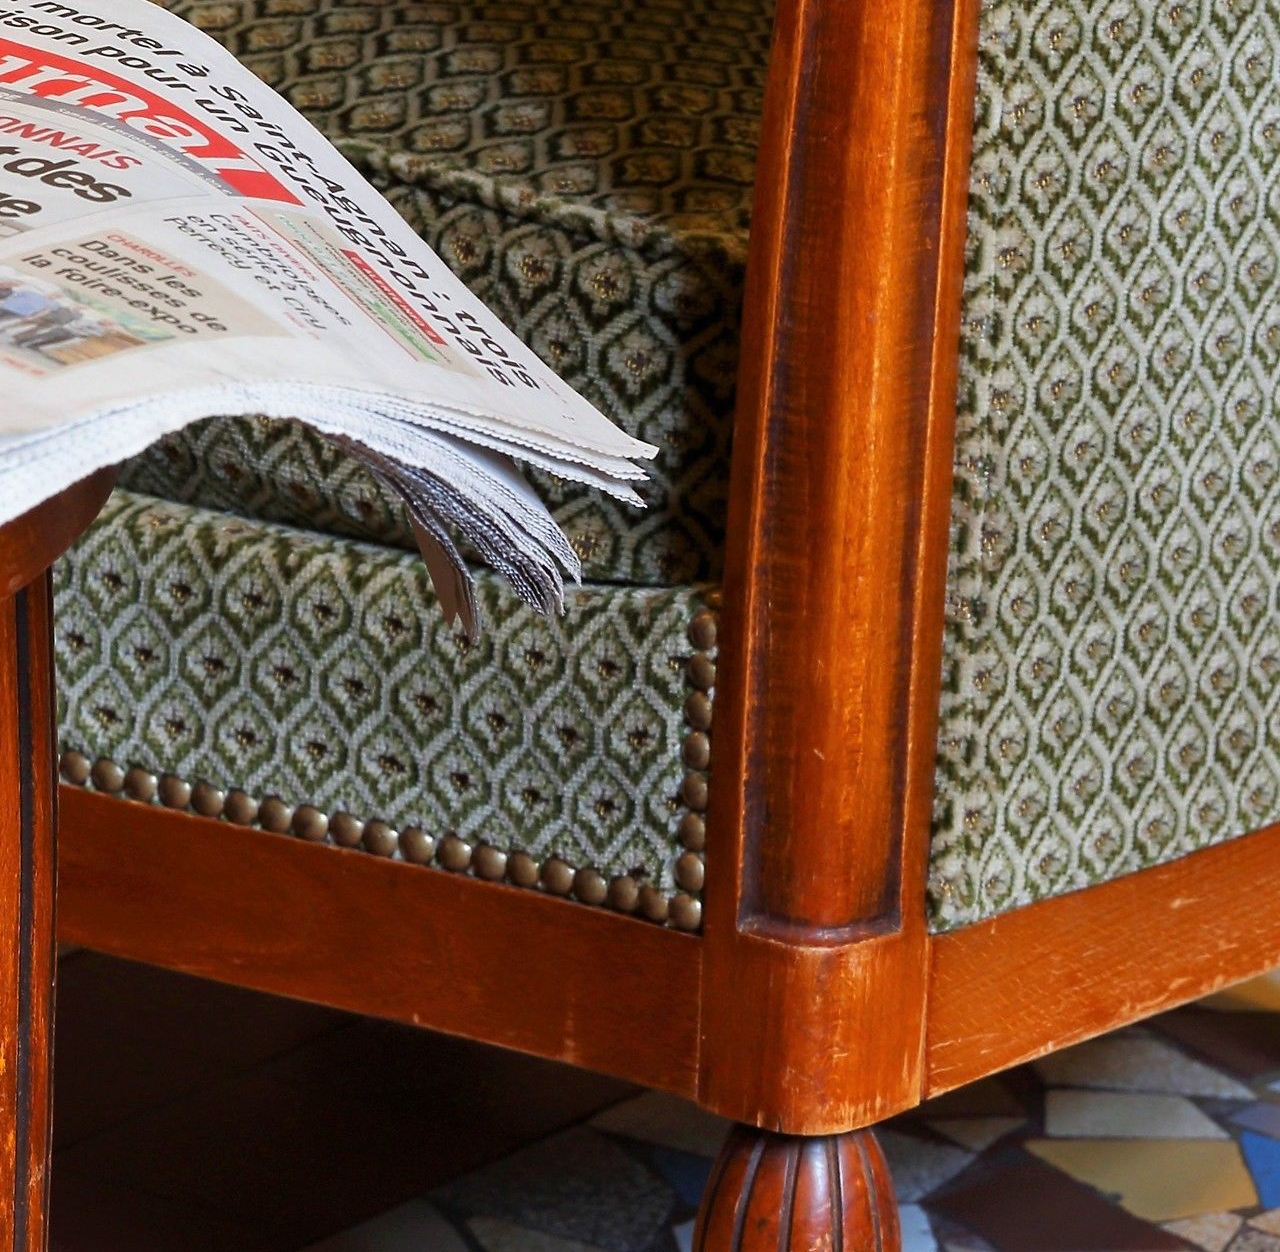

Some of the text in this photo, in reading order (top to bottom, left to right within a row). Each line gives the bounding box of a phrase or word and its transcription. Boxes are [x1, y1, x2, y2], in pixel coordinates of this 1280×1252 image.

[3, 158, 132, 203] des
[30, 1, 185, 57] mortel
[176, 62, 210, 78] à
[209, 85, 429, 280] Saint-Agnan
[455, 309, 540, 390] trois
[79, 46, 197, 92] pour
[195, 99, 249, 133] un
[254, 142, 515, 388] Gueugnonnais
[106, 234, 197, 278] CHAROLLES
[163, 217, 251, 269] Perrecy
[254, 275, 281, 291] et
[187, 215, 217, 232] en
[21, 254, 199, 335] la foire-expo
[51, 248, 228, 332] coulisses de
[79, 240, 204, 299] Dans les
[209, 214, 352, 327] Cambriolages
